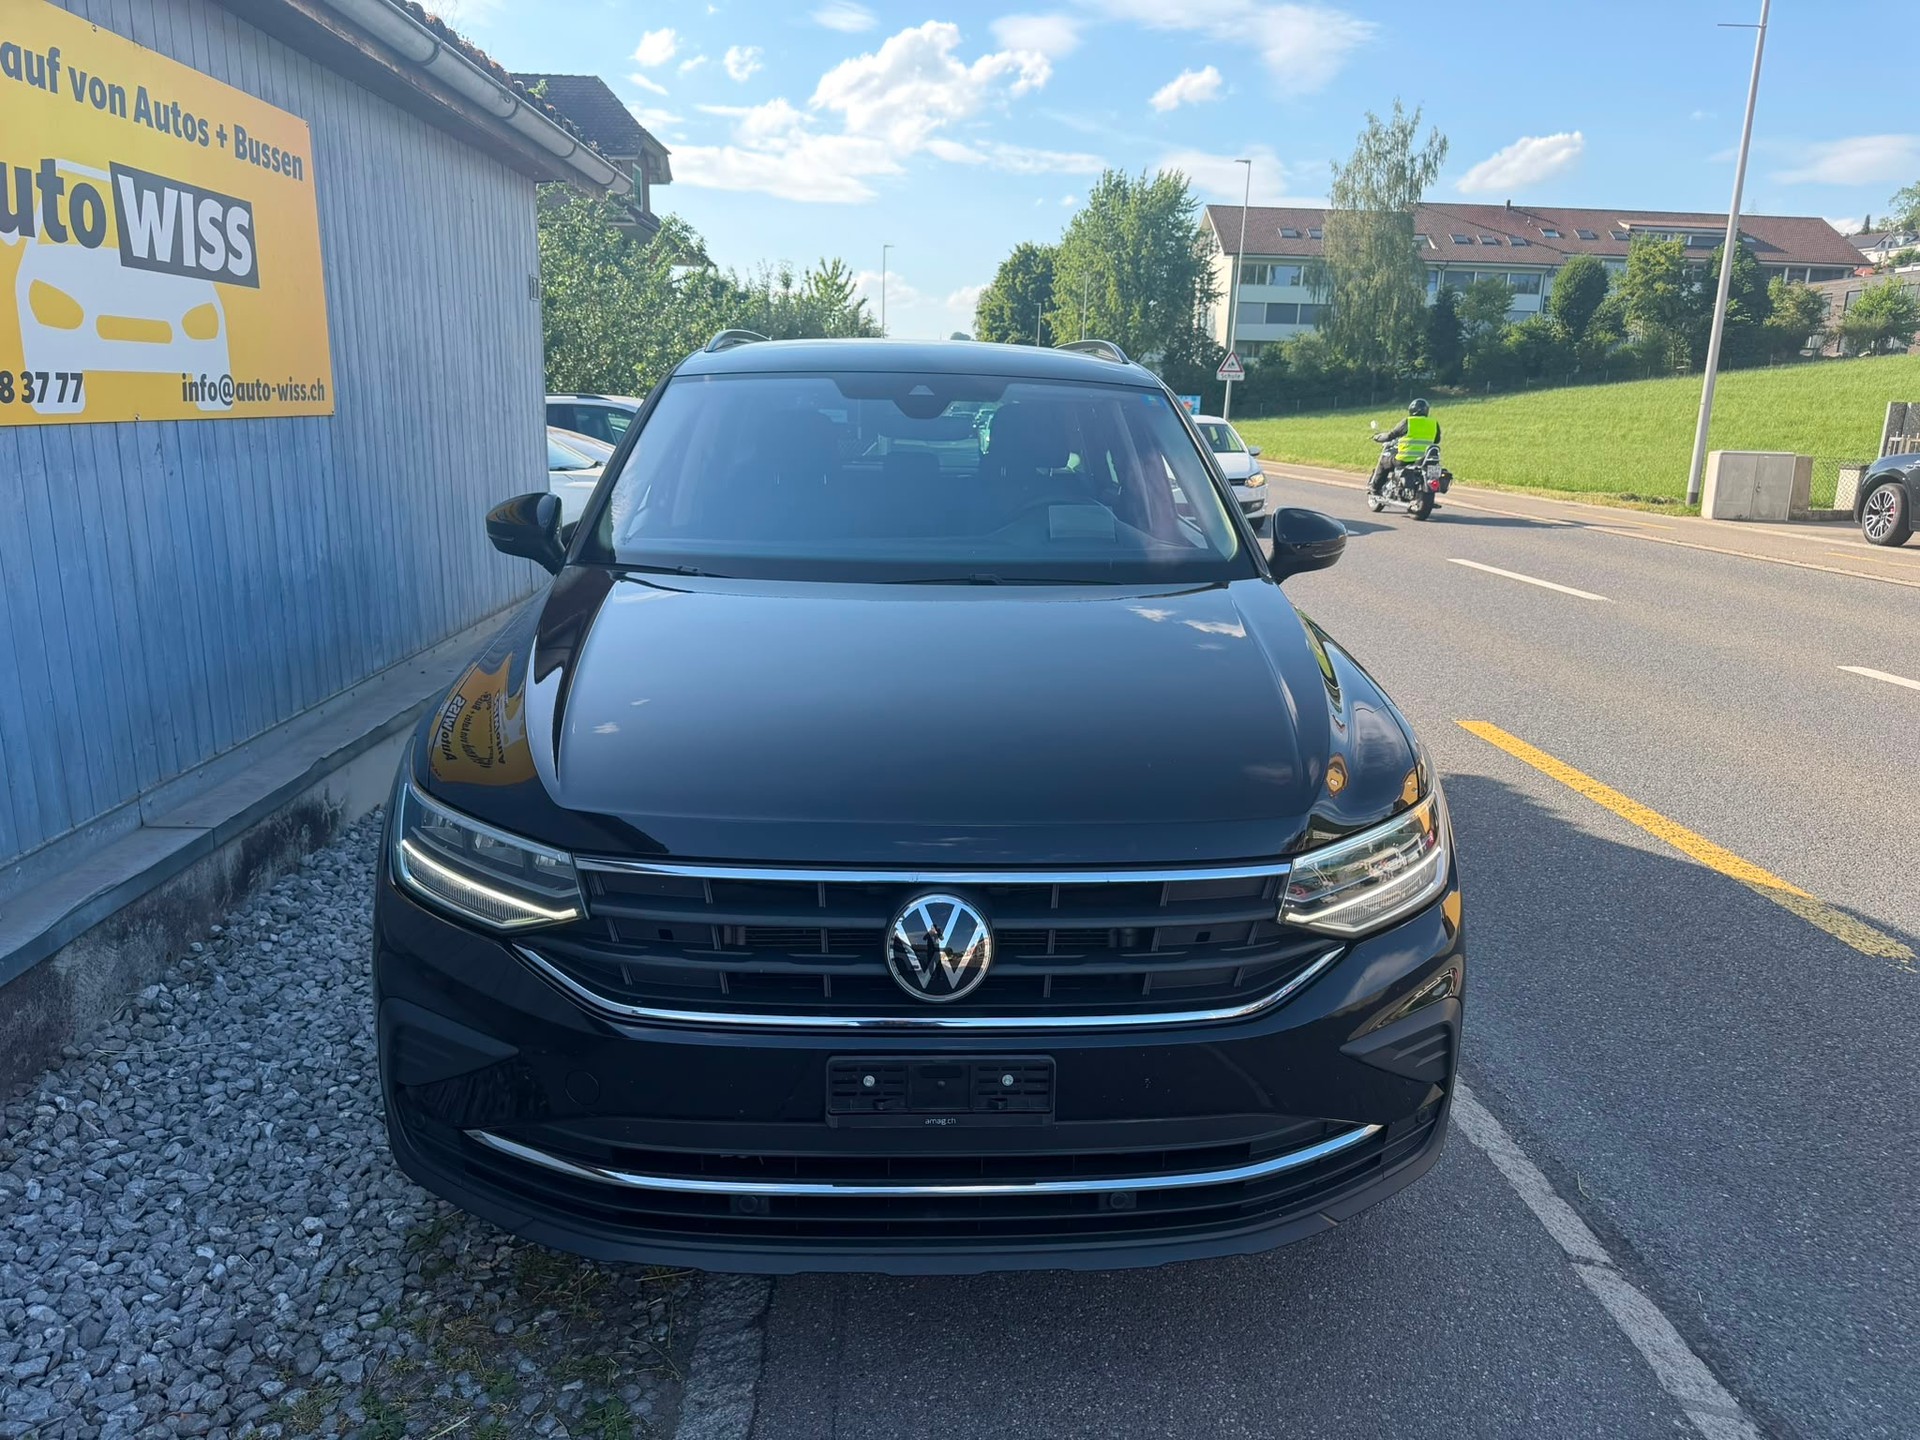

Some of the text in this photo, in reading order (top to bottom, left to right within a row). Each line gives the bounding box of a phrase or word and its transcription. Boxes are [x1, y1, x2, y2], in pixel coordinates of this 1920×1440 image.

[67, 65, 127, 119] von
[133, 85, 210, 148] Autos
[215, 123, 228, 149] +
[233, 123, 304, 182] Bussen
[117, 173, 253, 277] WISS
[20, 370, 50, 404] 37
[55, 371, 84, 403] 77
[181, 372, 326, 406] info@auto-wiss.ch
[892, 897, 992, 992] VW
[924, 1117, 957, 1126] amag.ch
